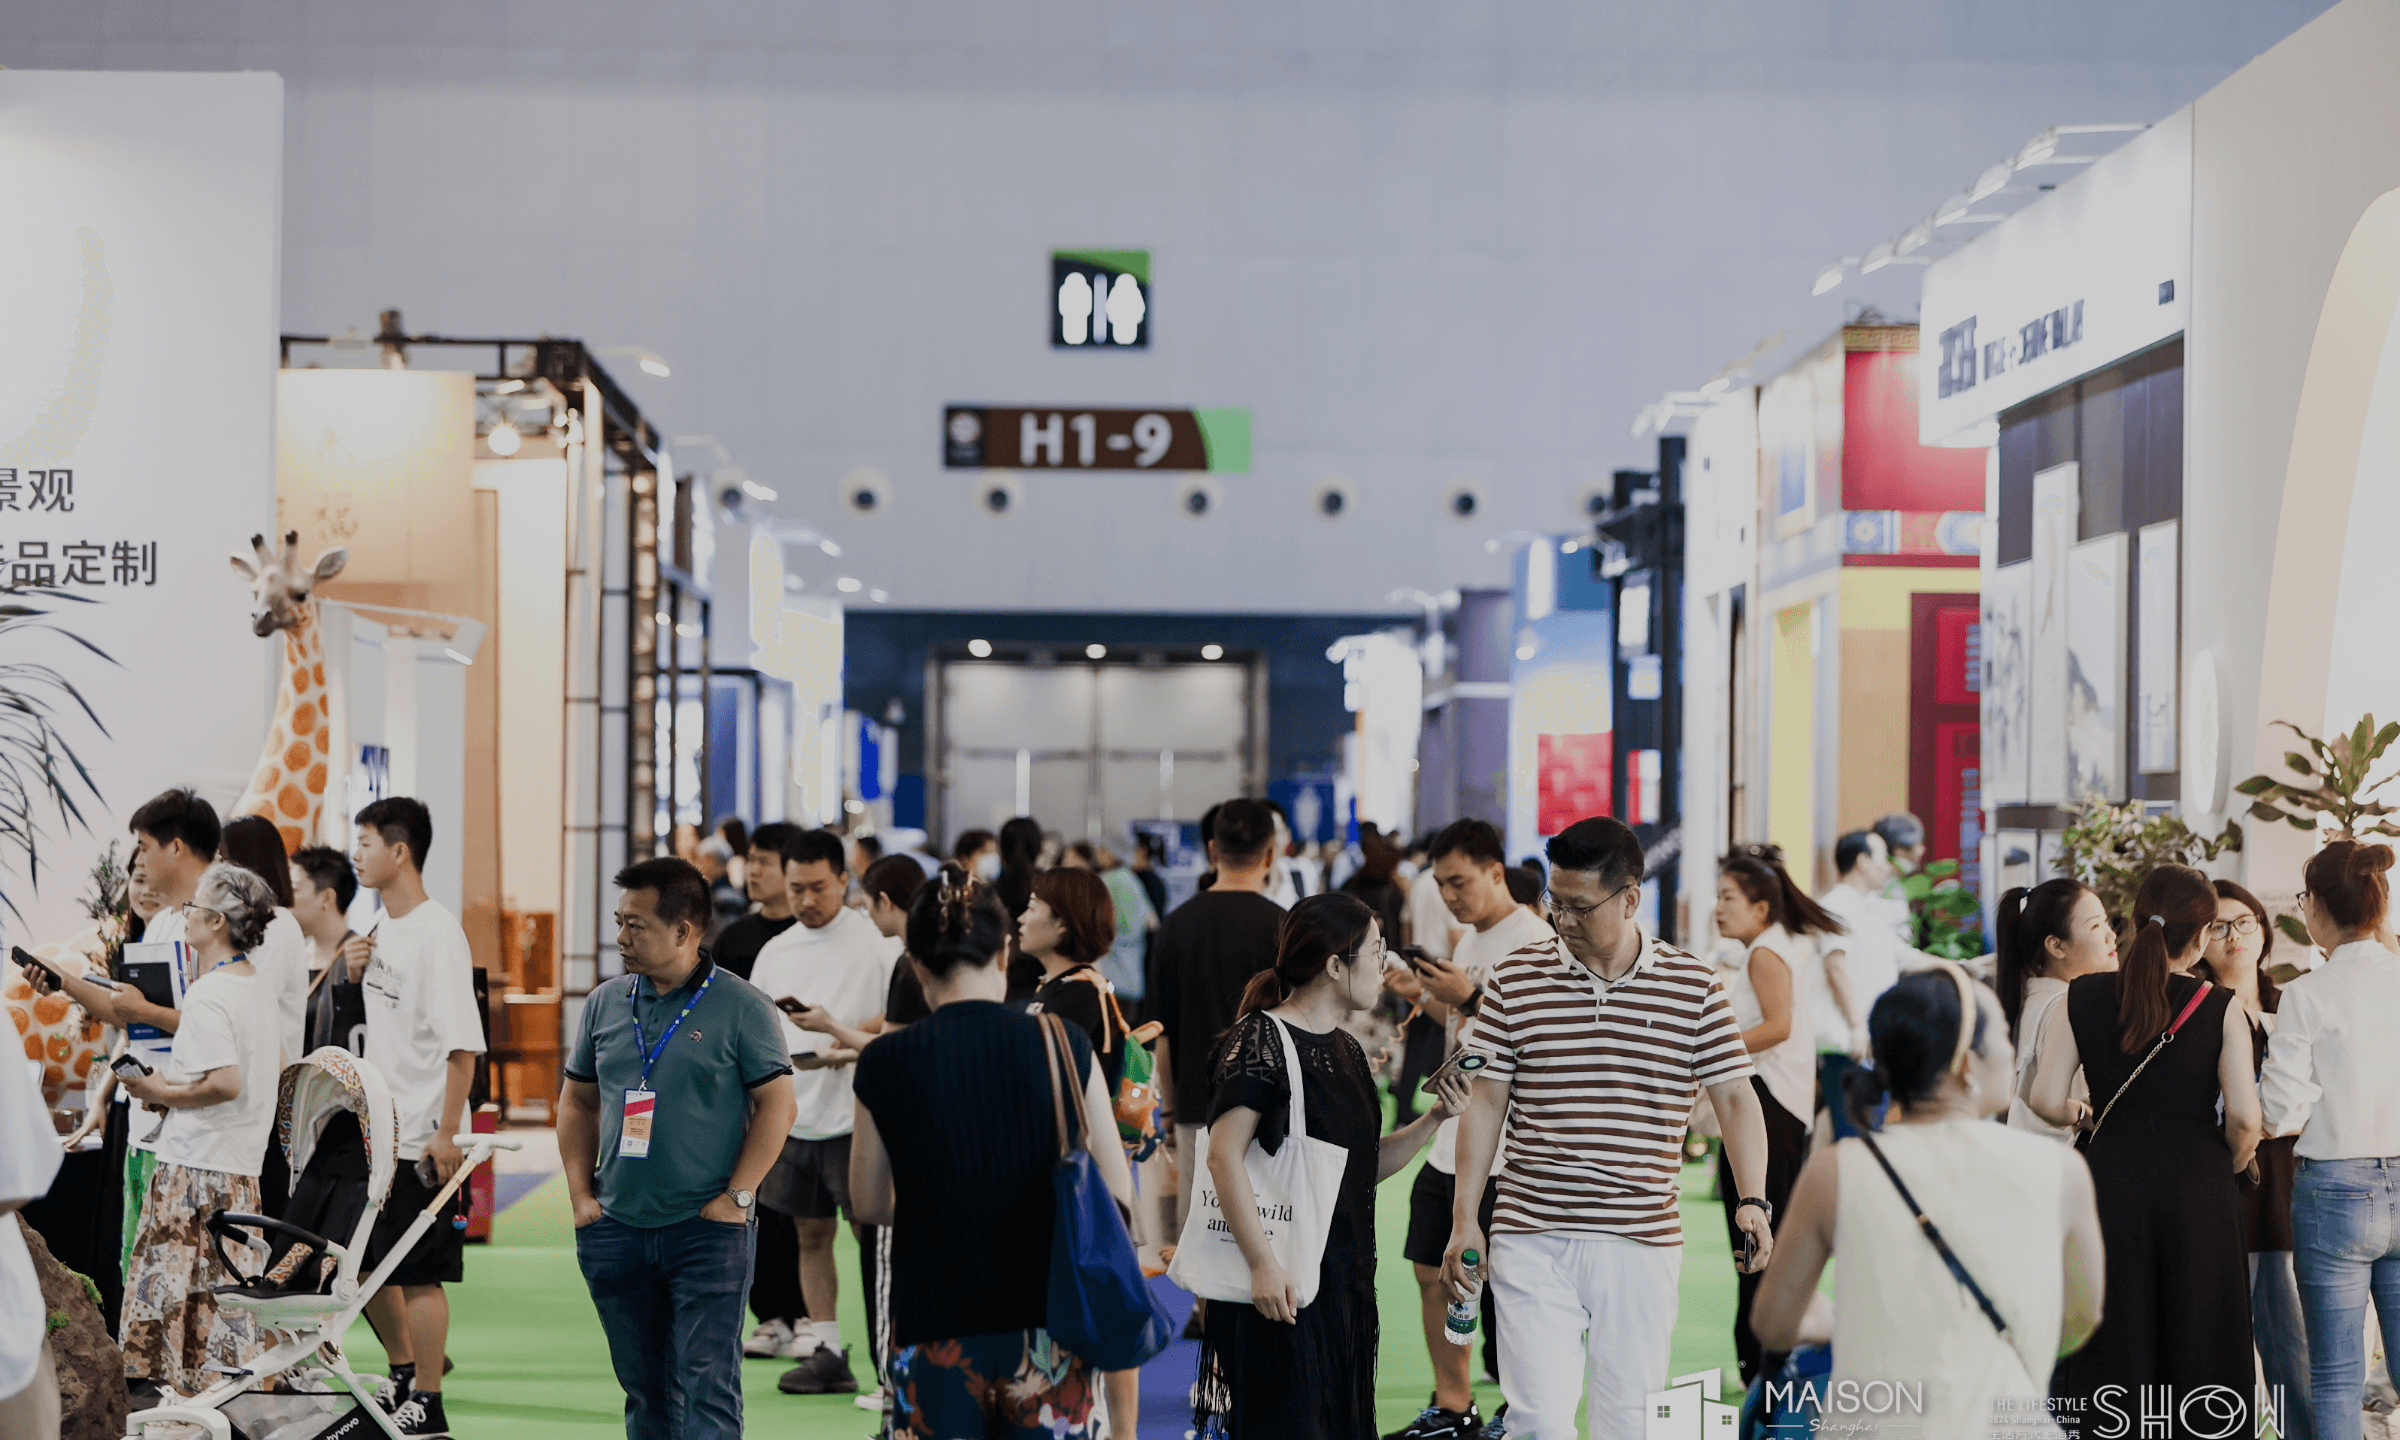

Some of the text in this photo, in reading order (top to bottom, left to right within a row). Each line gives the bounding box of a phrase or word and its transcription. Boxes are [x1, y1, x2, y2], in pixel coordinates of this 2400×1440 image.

[1020, 412, 1173, 468] H1-9
[0, 540, 157, 586] 品定制
